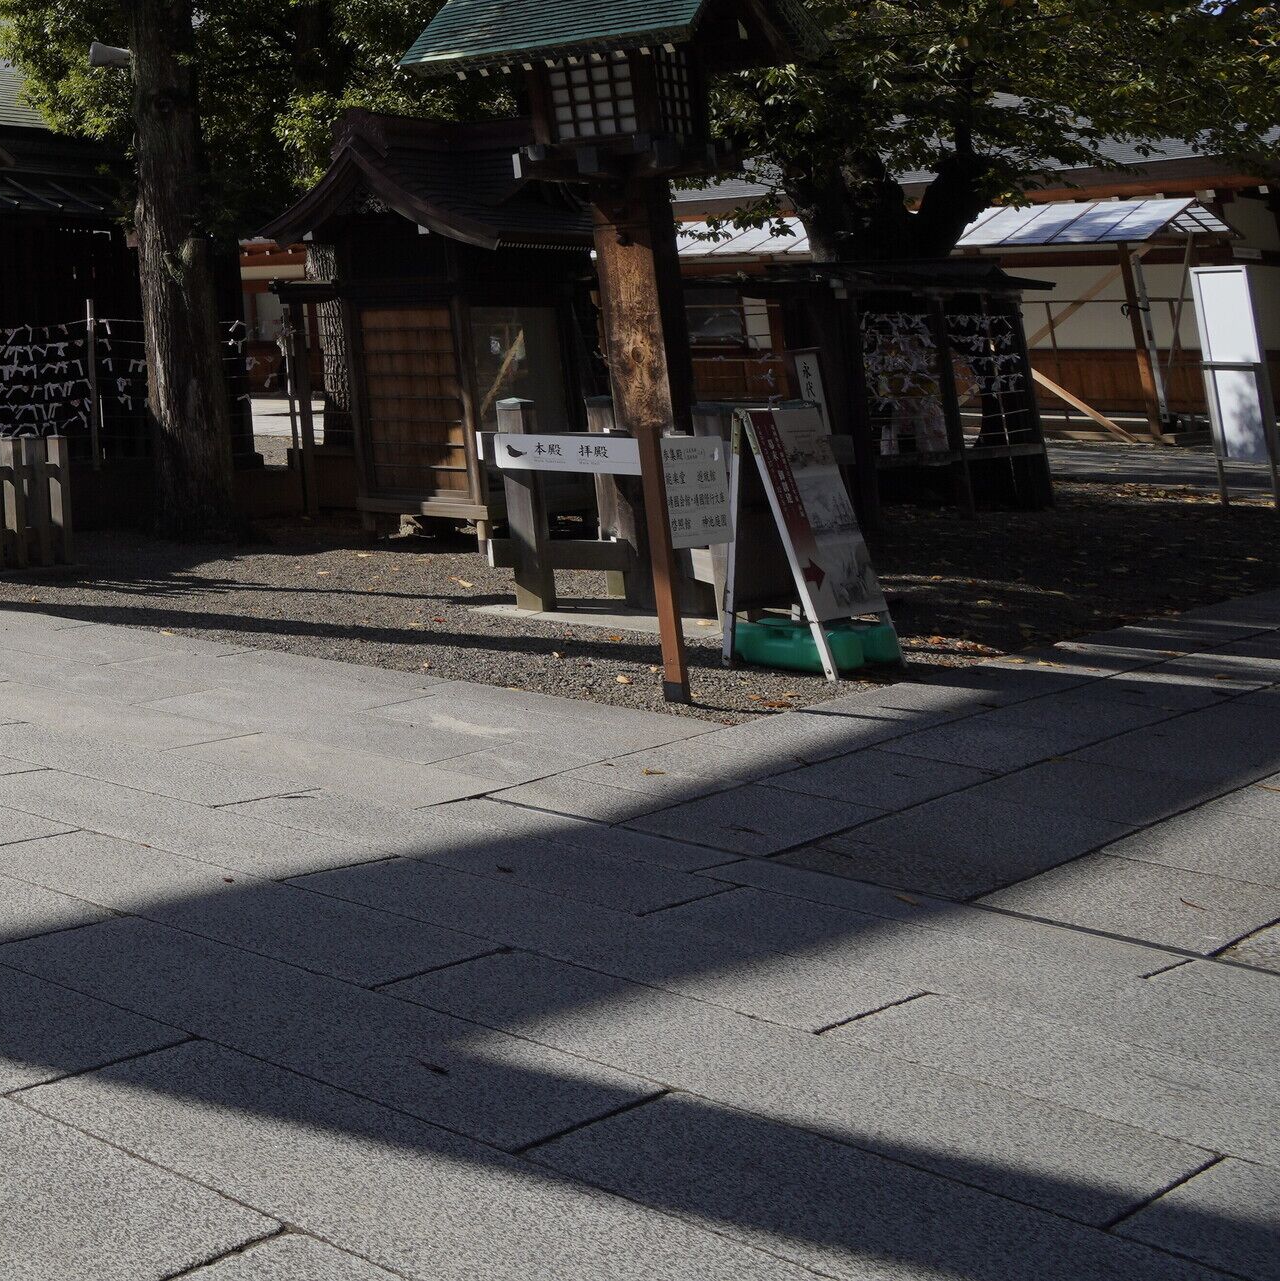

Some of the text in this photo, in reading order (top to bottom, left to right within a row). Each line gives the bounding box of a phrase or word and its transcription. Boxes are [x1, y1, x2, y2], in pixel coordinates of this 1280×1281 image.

[534, 441, 563, 457] 本殿
[578, 444, 609, 459] 拝殿
[663, 448, 684, 462] 参集殿
